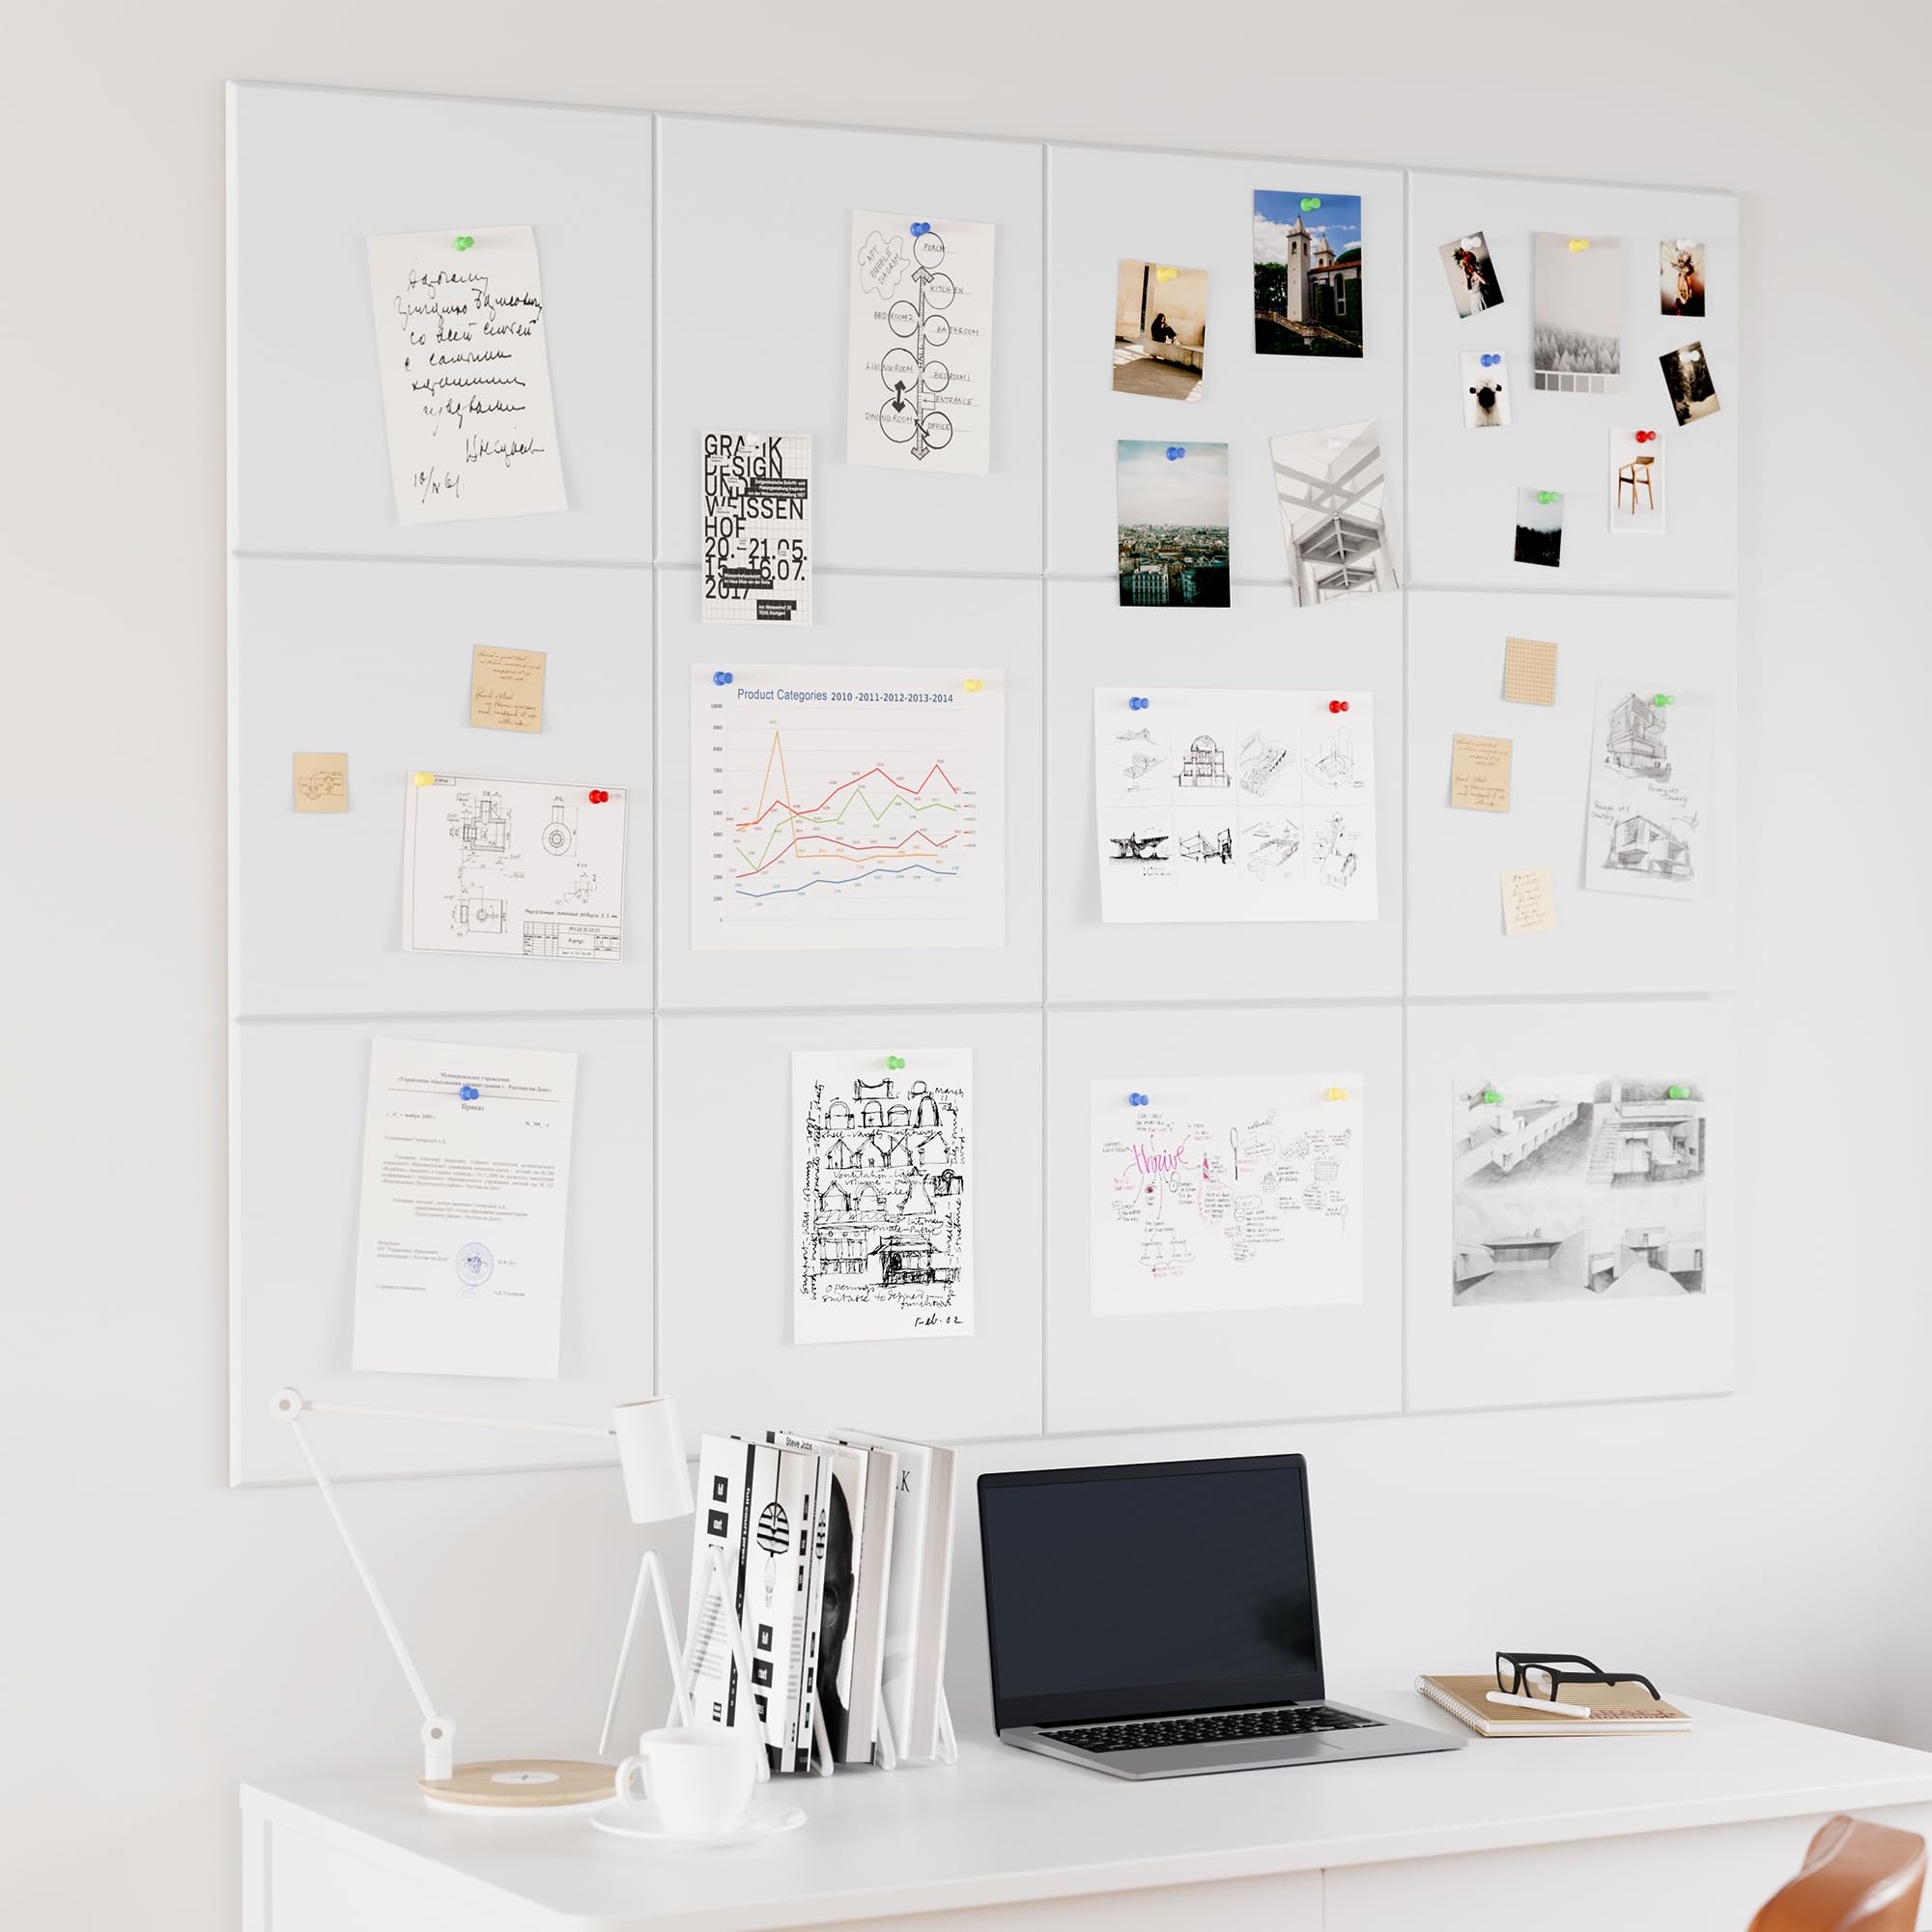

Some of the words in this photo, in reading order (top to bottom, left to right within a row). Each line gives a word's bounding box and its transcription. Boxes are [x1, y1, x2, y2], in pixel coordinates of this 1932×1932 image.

[923, 242, 945, 252] PORCH
[929, 285, 965, 295] KITCHEN
[936, 326, 980, 336] BATHROOM
[935, 396, 973, 406] ENTRANCE
[927, 422, 950, 431] OFFICE
[704, 434, 782, 458] GRAIK
[705, 496, 805, 520] WEISSEN
[704, 516, 747, 538] HOF
[737, 688, 775, 701] Product
[778, 689, 828, 703] Categories
[831, 692, 853, 702] 2010
[1132, 1144, 1189, 1174] thrive
[785, 1436, 800, 1448] Steve
[801, 1440, 813, 1451] Jobs
